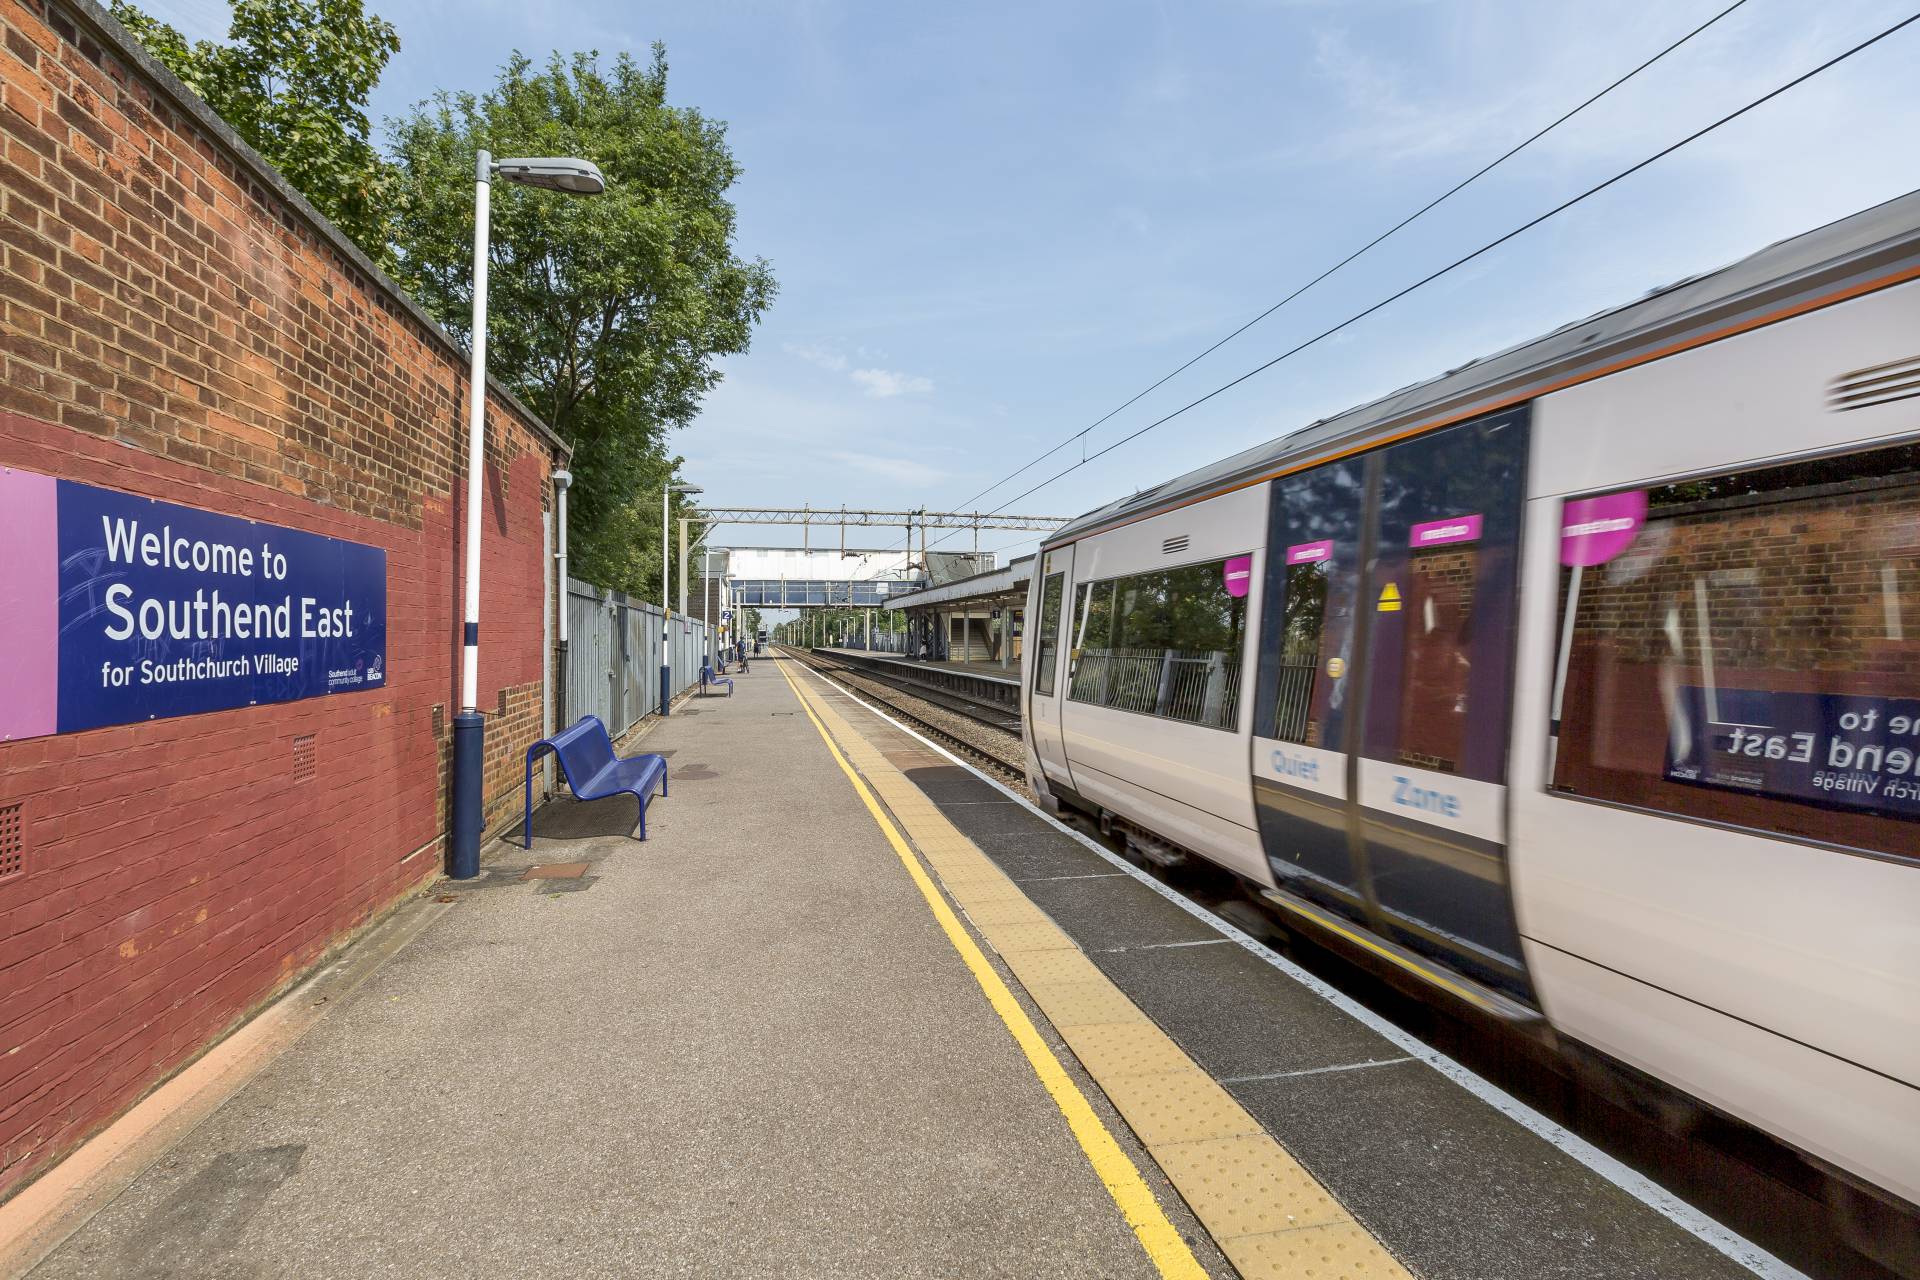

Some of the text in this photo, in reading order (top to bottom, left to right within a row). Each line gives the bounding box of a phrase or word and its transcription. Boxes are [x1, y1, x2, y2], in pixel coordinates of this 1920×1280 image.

[102, 515, 288, 581] Welcome to
[104, 583, 353, 641] Southend East
[724, 611, 730, 619] 2
[102, 653, 299, 688] for Southchurch Village
[328, 669, 348, 678] Southend
[1270, 749, 1463, 818] Quiet Zone
